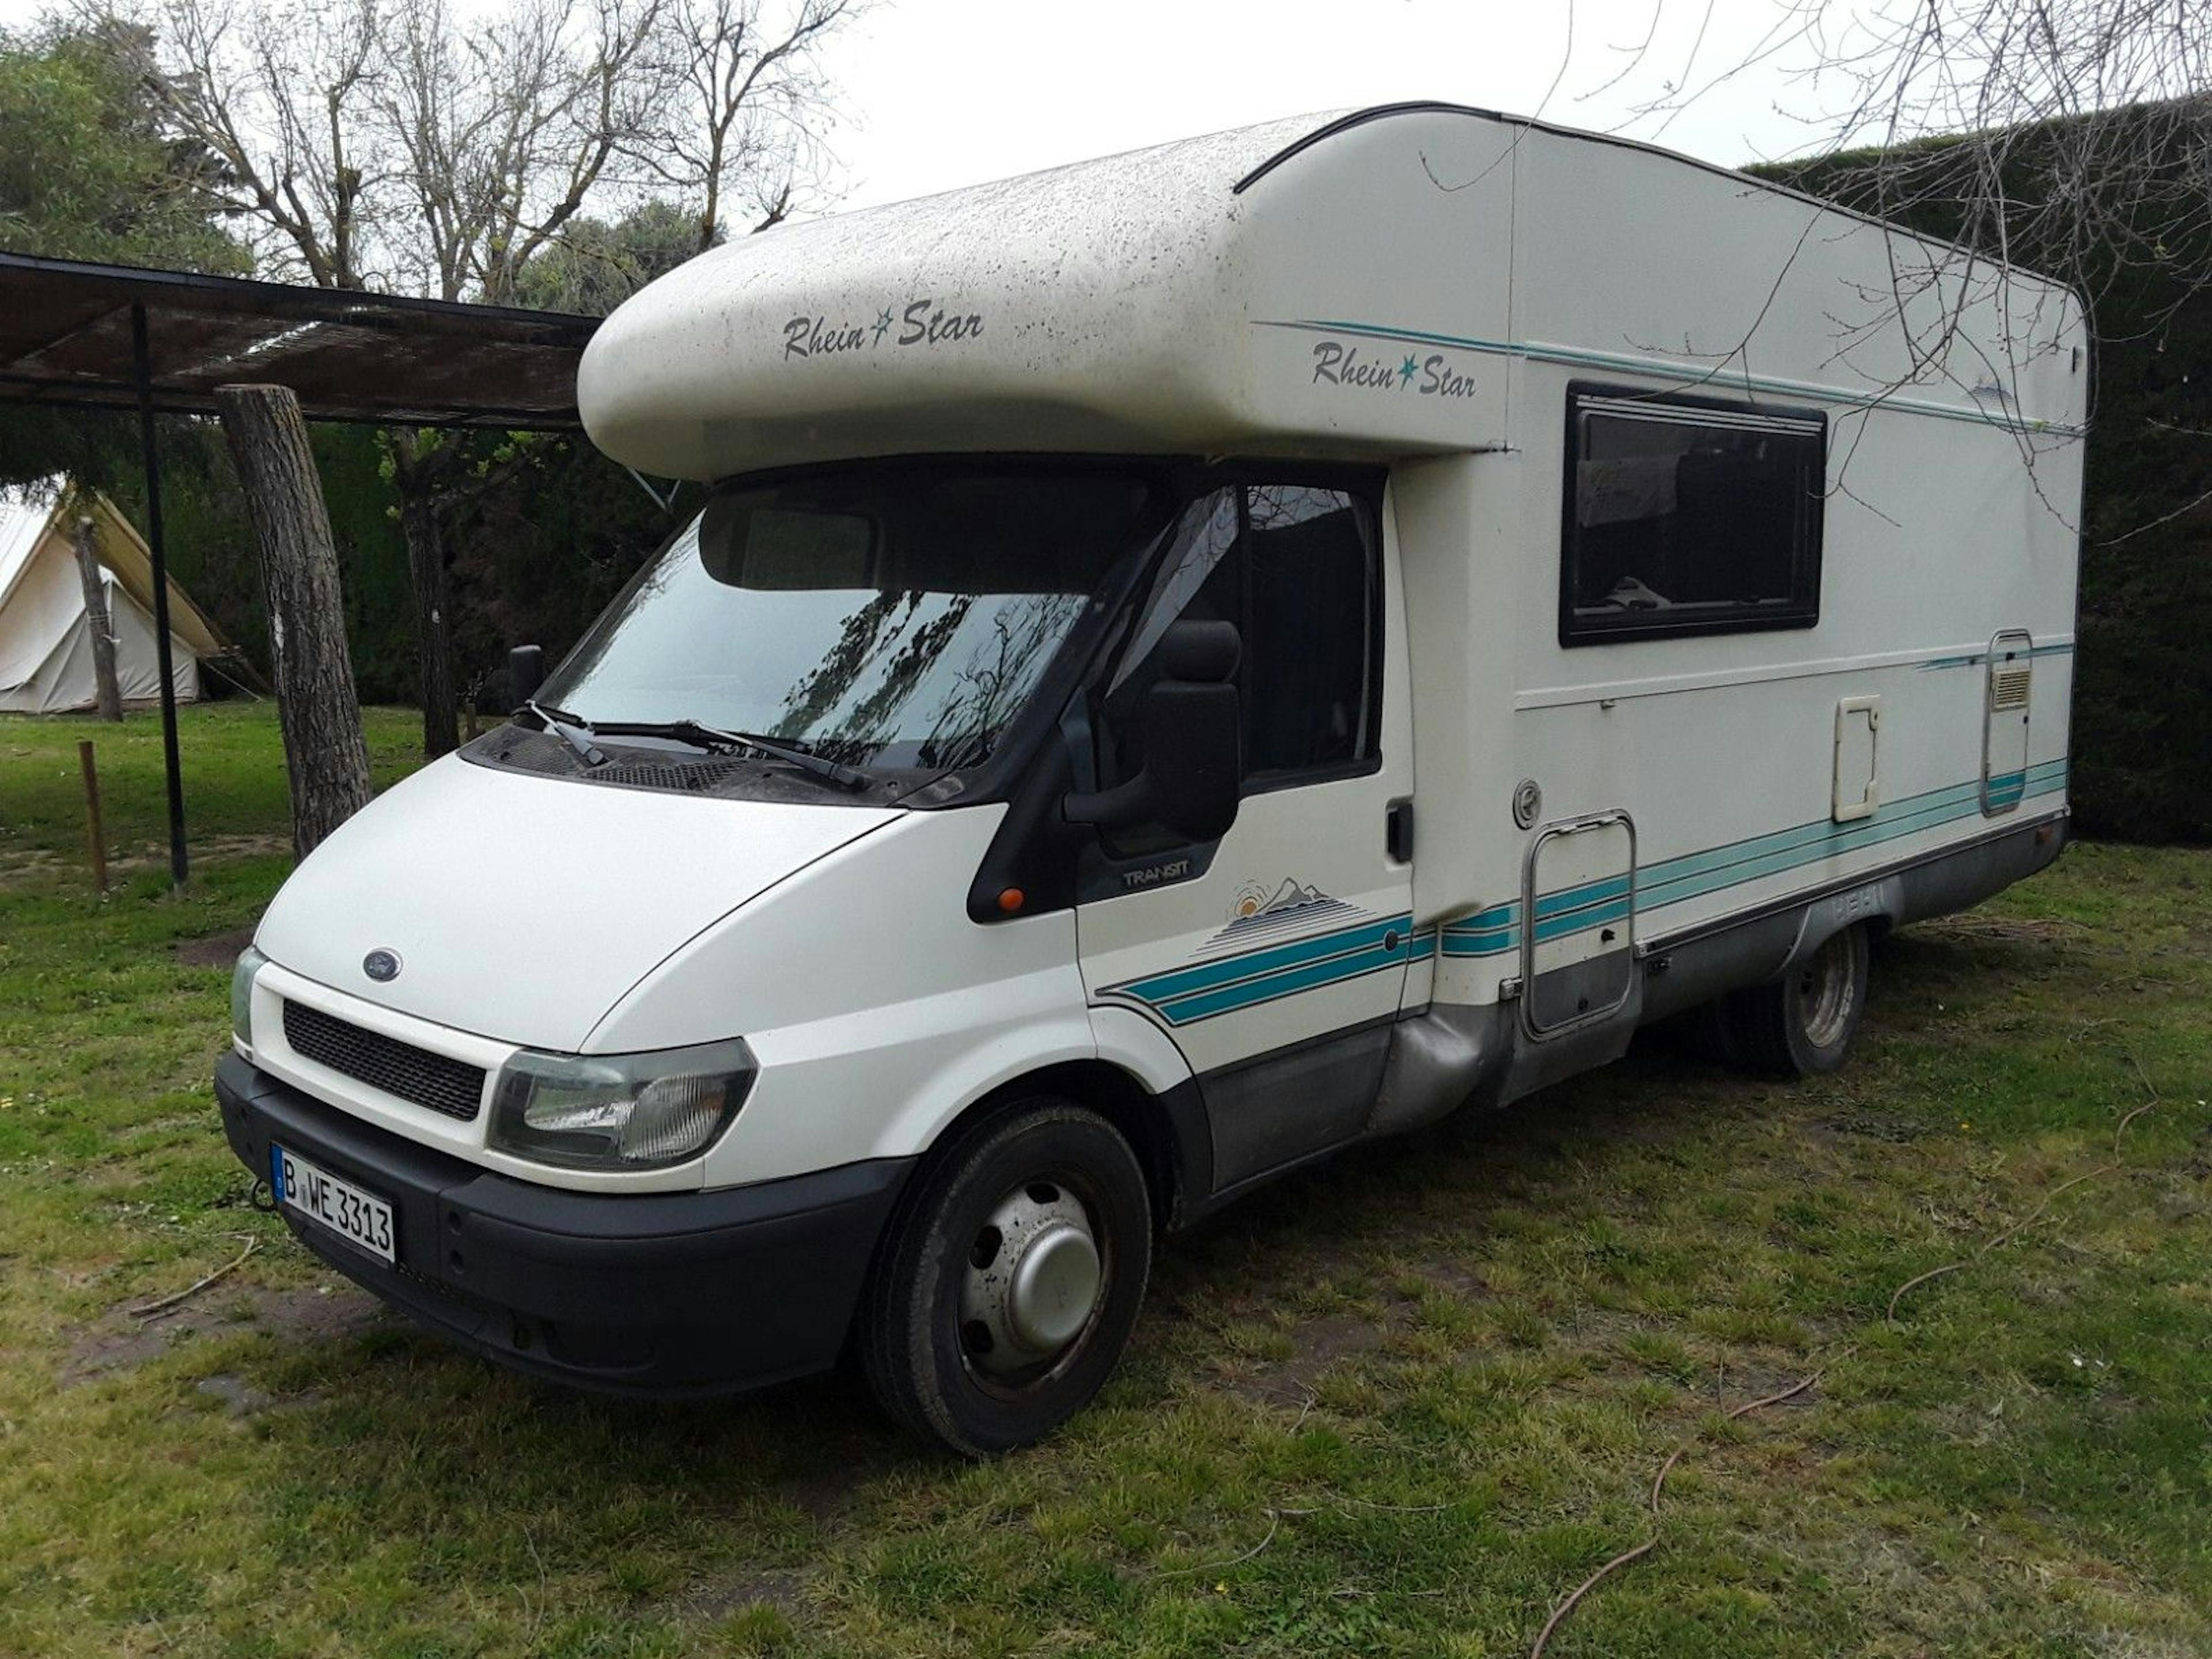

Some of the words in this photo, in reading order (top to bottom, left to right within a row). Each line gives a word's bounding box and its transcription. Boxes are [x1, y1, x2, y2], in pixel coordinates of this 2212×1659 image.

[783, 315, 866, 362] Rhein
[898, 299, 986, 346] Star
[1313, 342, 1395, 389] Rhein
[1419, 354, 1477, 398] Star
[1124, 859, 1189, 886] TRANSIT
[284, 1158, 297, 1199] B
[336, 1187, 390, 1251] 3313
